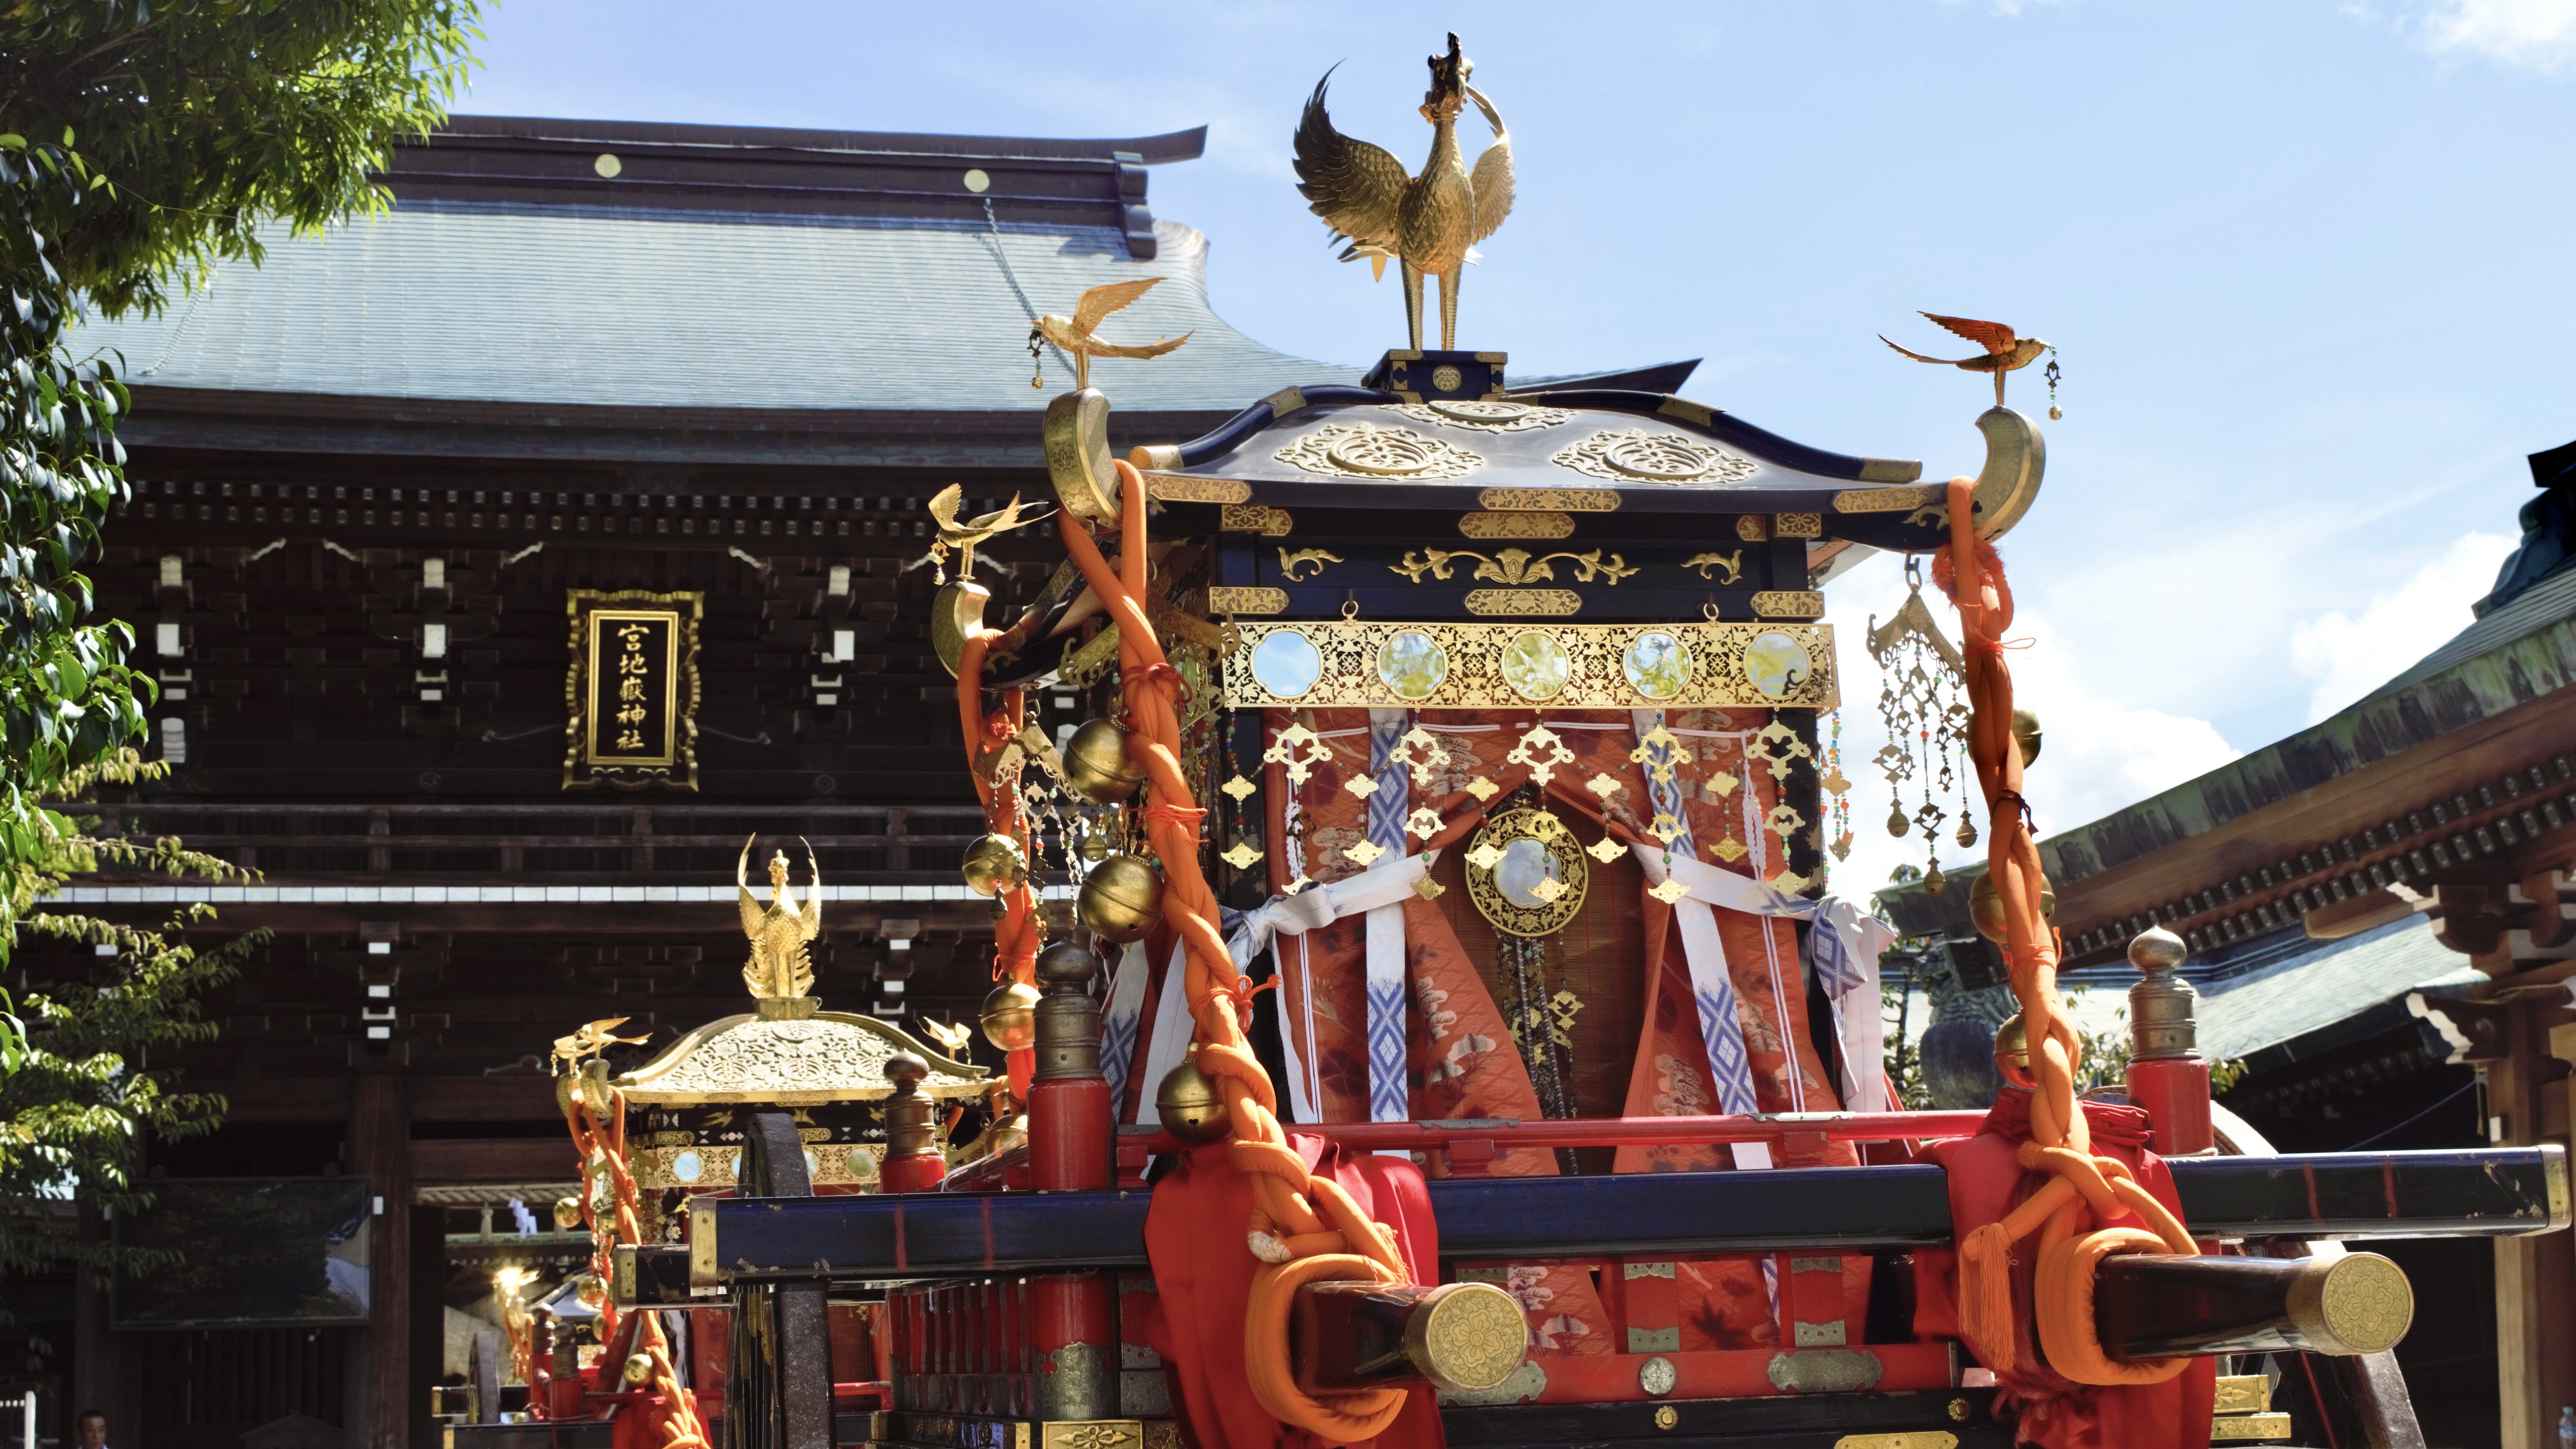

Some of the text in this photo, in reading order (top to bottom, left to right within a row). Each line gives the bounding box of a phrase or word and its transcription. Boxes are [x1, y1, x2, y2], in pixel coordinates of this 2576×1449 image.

[616, 624, 650, 750] 宮地嶽神社
